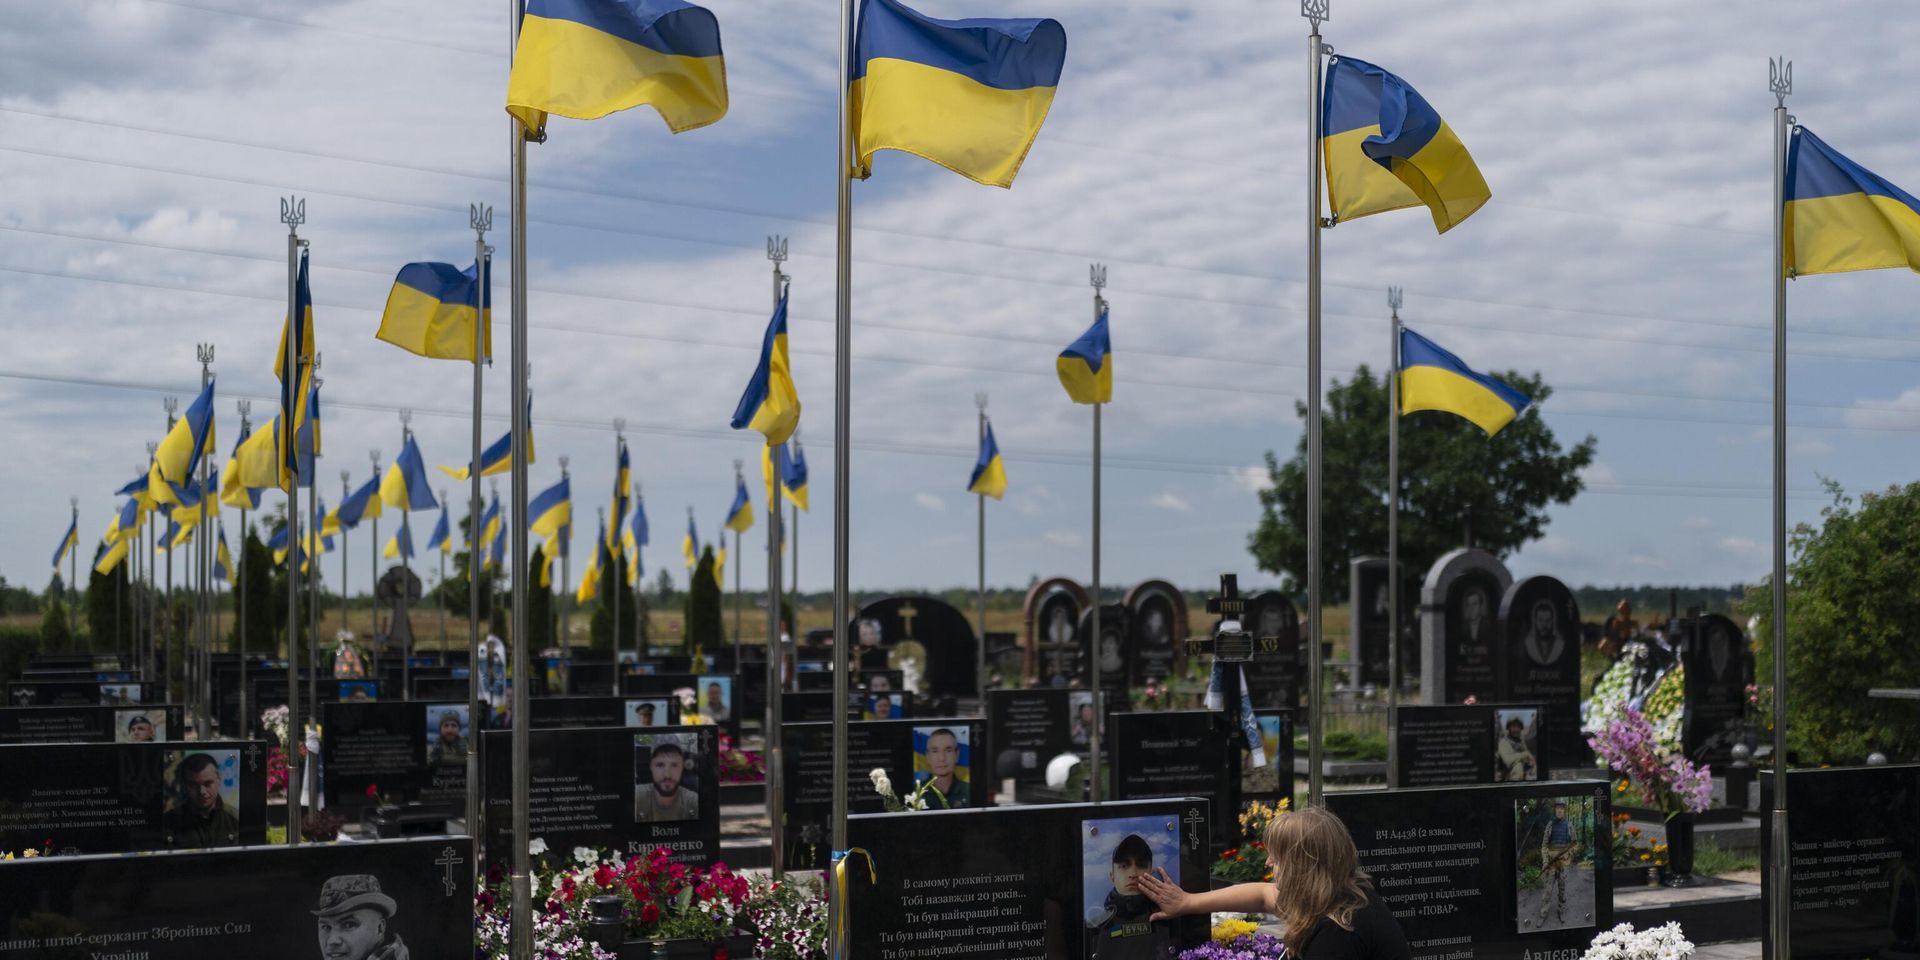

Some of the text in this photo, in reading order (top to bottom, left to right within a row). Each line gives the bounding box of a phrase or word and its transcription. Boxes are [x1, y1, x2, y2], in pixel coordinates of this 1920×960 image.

[651, 825, 680, 837] Воля
[1375, 829, 1388, 840] ВЧ
[1428, 827, 1454, 838] взвод,
[1370, 845, 1425, 857] спеціального
[1427, 839, 1486, 854] призначення).
[1359, 857, 1480, 873] ржант, заступник командира
[1792, 856, 1818, 867] Посада
[903, 873, 1025, 889] В самому розквіті життя
[1379, 875, 1451, 887] бойової машини,
[900, 888, 1027, 906] Тобі назавжди 20 років...
[1381, 892, 1428, 904] к-оператор
[1436, 886, 1482, 899] відділення.
[905, 904, 1022, 924] Ти був найкращий син!
[1419, 903, 1459, 915] «ПОВАР»
[0, 921, 252, 951] ання: штаб-сержант Збройних Сил
[880, 919, 1047, 944] Ти був найкращий старший брат!
[882, 936, 1045, 960] Ти був найулюбленіший внучок!
[1427, 935, 1472, 947] виконання
[1446, 949, 1473, 960] районі
